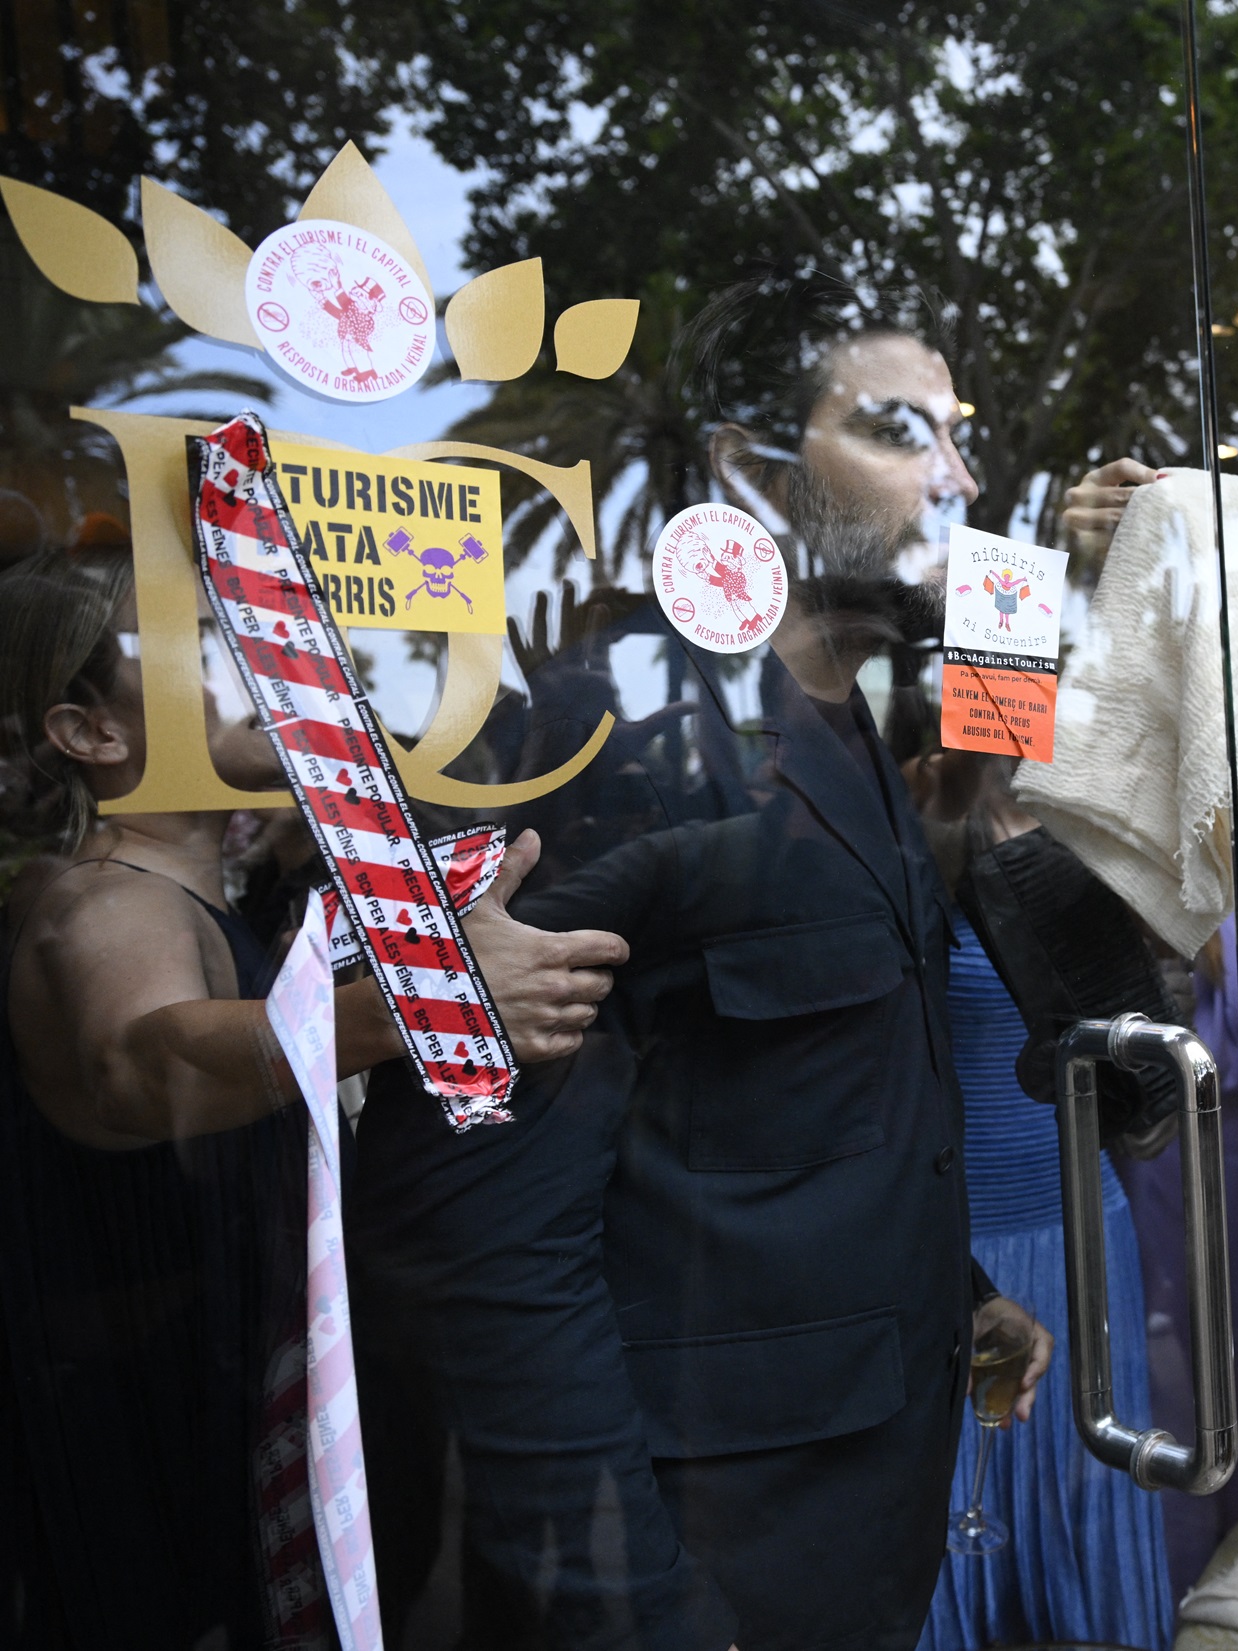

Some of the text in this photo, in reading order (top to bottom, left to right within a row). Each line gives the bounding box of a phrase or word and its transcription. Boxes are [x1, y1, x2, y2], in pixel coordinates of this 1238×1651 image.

[256, 230, 412, 292] CONTRA EL TURISME I EL CAPITAL
[278, 334, 428, 393] RESPOSTA ORGANITZADA I VEÏNAL
[264, 478, 282, 510] CONTRA
[282, 463, 481, 523] TURISME
[277, 508, 287, 520] EL
[211, 519, 233, 568] VEÏNES
[282, 520, 300, 550] CAPITAL
[300, 520, 381, 566] ATA
[662, 510, 755, 594] CONTRA EL TURISME I EL CAPITAL
[971, 548, 1045, 581] niGuiris
[295, 554, 312, 584] CONTRA
[308, 582, 318, 594] EL
[322, 573, 396, 617] RRIS
[312, 594, 330, 626] CAPITAL
[695, 624, 735, 645] RESPOSTA
[738, 604, 780, 645] ORGANITZADA
[771, 565, 783, 596] VEÏNAL
[239, 606, 260, 634] PER
[963, 617, 1047, 647] ni Souvenirs
[326, 627, 343, 657] CONTRA
[234, 652, 256, 691] DEFENSEM
[338, 656, 349, 666] EL
[948, 651, 1055, 670] #BcnAgainstTourism
[343, 666, 358, 696] CAPITAL
[254, 691, 263, 703] LA
[268, 676, 298, 718] VEÏNES
[953, 688, 978, 701] SALVEM
[981, 692, 989, 702] EL
[1018, 701, 1026, 710] DE
[1028, 702, 1048, 714] BARRI
[258, 703, 270, 722] VIDA
[357, 704, 375, 733] CONTRA
[970, 708, 995, 720] CONTRA
[1010, 716, 1031, 728] PREUS
[370, 733, 378, 742] EL
[963, 725, 991, 738] ABUSIUS
[993, 730, 1005, 740] DEL
[270, 732, 292, 772] DEFENSEM
[374, 742, 392, 772] CAPITAL
[243, 488, 278, 555] POPULAR
[274, 568, 312, 638] PRECINTE
[304, 638, 340, 703] POPULAR
[338, 718, 374, 784] PRECINTE
[366, 784, 400, 847] POPULAR
[397, 858, 433, 922] PRECINTE
[425, 922, 458, 983] POPULAR
[455, 992, 489, 1054] PRECINTE
[288, 773, 298, 783] LA
[305, 757, 324, 784] PER
[293, 784, 306, 802] VIDA
[316, 786, 328, 794] A
[387, 774, 406, 803] CONTRA
[320, 795, 340, 820] LES
[400, 803, 409, 812] EL
[302, 806, 324, 844] DEFENSEM
[404, 813, 421, 840] CAPITAL
[428, 825, 497, 847] CONTRA EL CAPITAL
[320, 844, 330, 854] LA
[332, 820, 360, 866] VEÏNES
[324, 855, 337, 873] VIDA
[417, 844, 434, 870] CONTRA
[355, 872, 375, 900] BCN
[428, 871, 437, 880] EL
[334, 876, 355, 913] DEFENSEM
[432, 880, 450, 908] CAPITAL
[350, 913, 360, 923] LA
[367, 900, 386, 925] PER
[446, 911, 462, 938] CONTRA
[355, 924, 368, 942] VIDA
[377, 926, 389, 936] A
[457, 938, 466, 948] EL
[382, 935, 400, 960] LES
[460, 946, 476, 973] CAPITAL
[364, 946, 385, 982] DEFENSEM
[380, 982, 390, 992] LA
[393, 959, 420, 1003] VEÏNES
[473, 976, 488, 1002] CONTRA
[385, 993, 395, 1010] VIDA
[483, 1002, 492, 1011] EL
[393, 1013, 414, 1049] DEFENSEM
[414, 1008, 432, 1034] BCN
[487, 1011, 502, 1037] CAPITAL
[410, 1049, 418, 1058] LA
[425, 1034, 444, 1059] PER
[500, 1040, 514, 1065] CONTRA
[414, 1059, 426, 1075] VIDA
[435, 1060, 447, 1068] A
